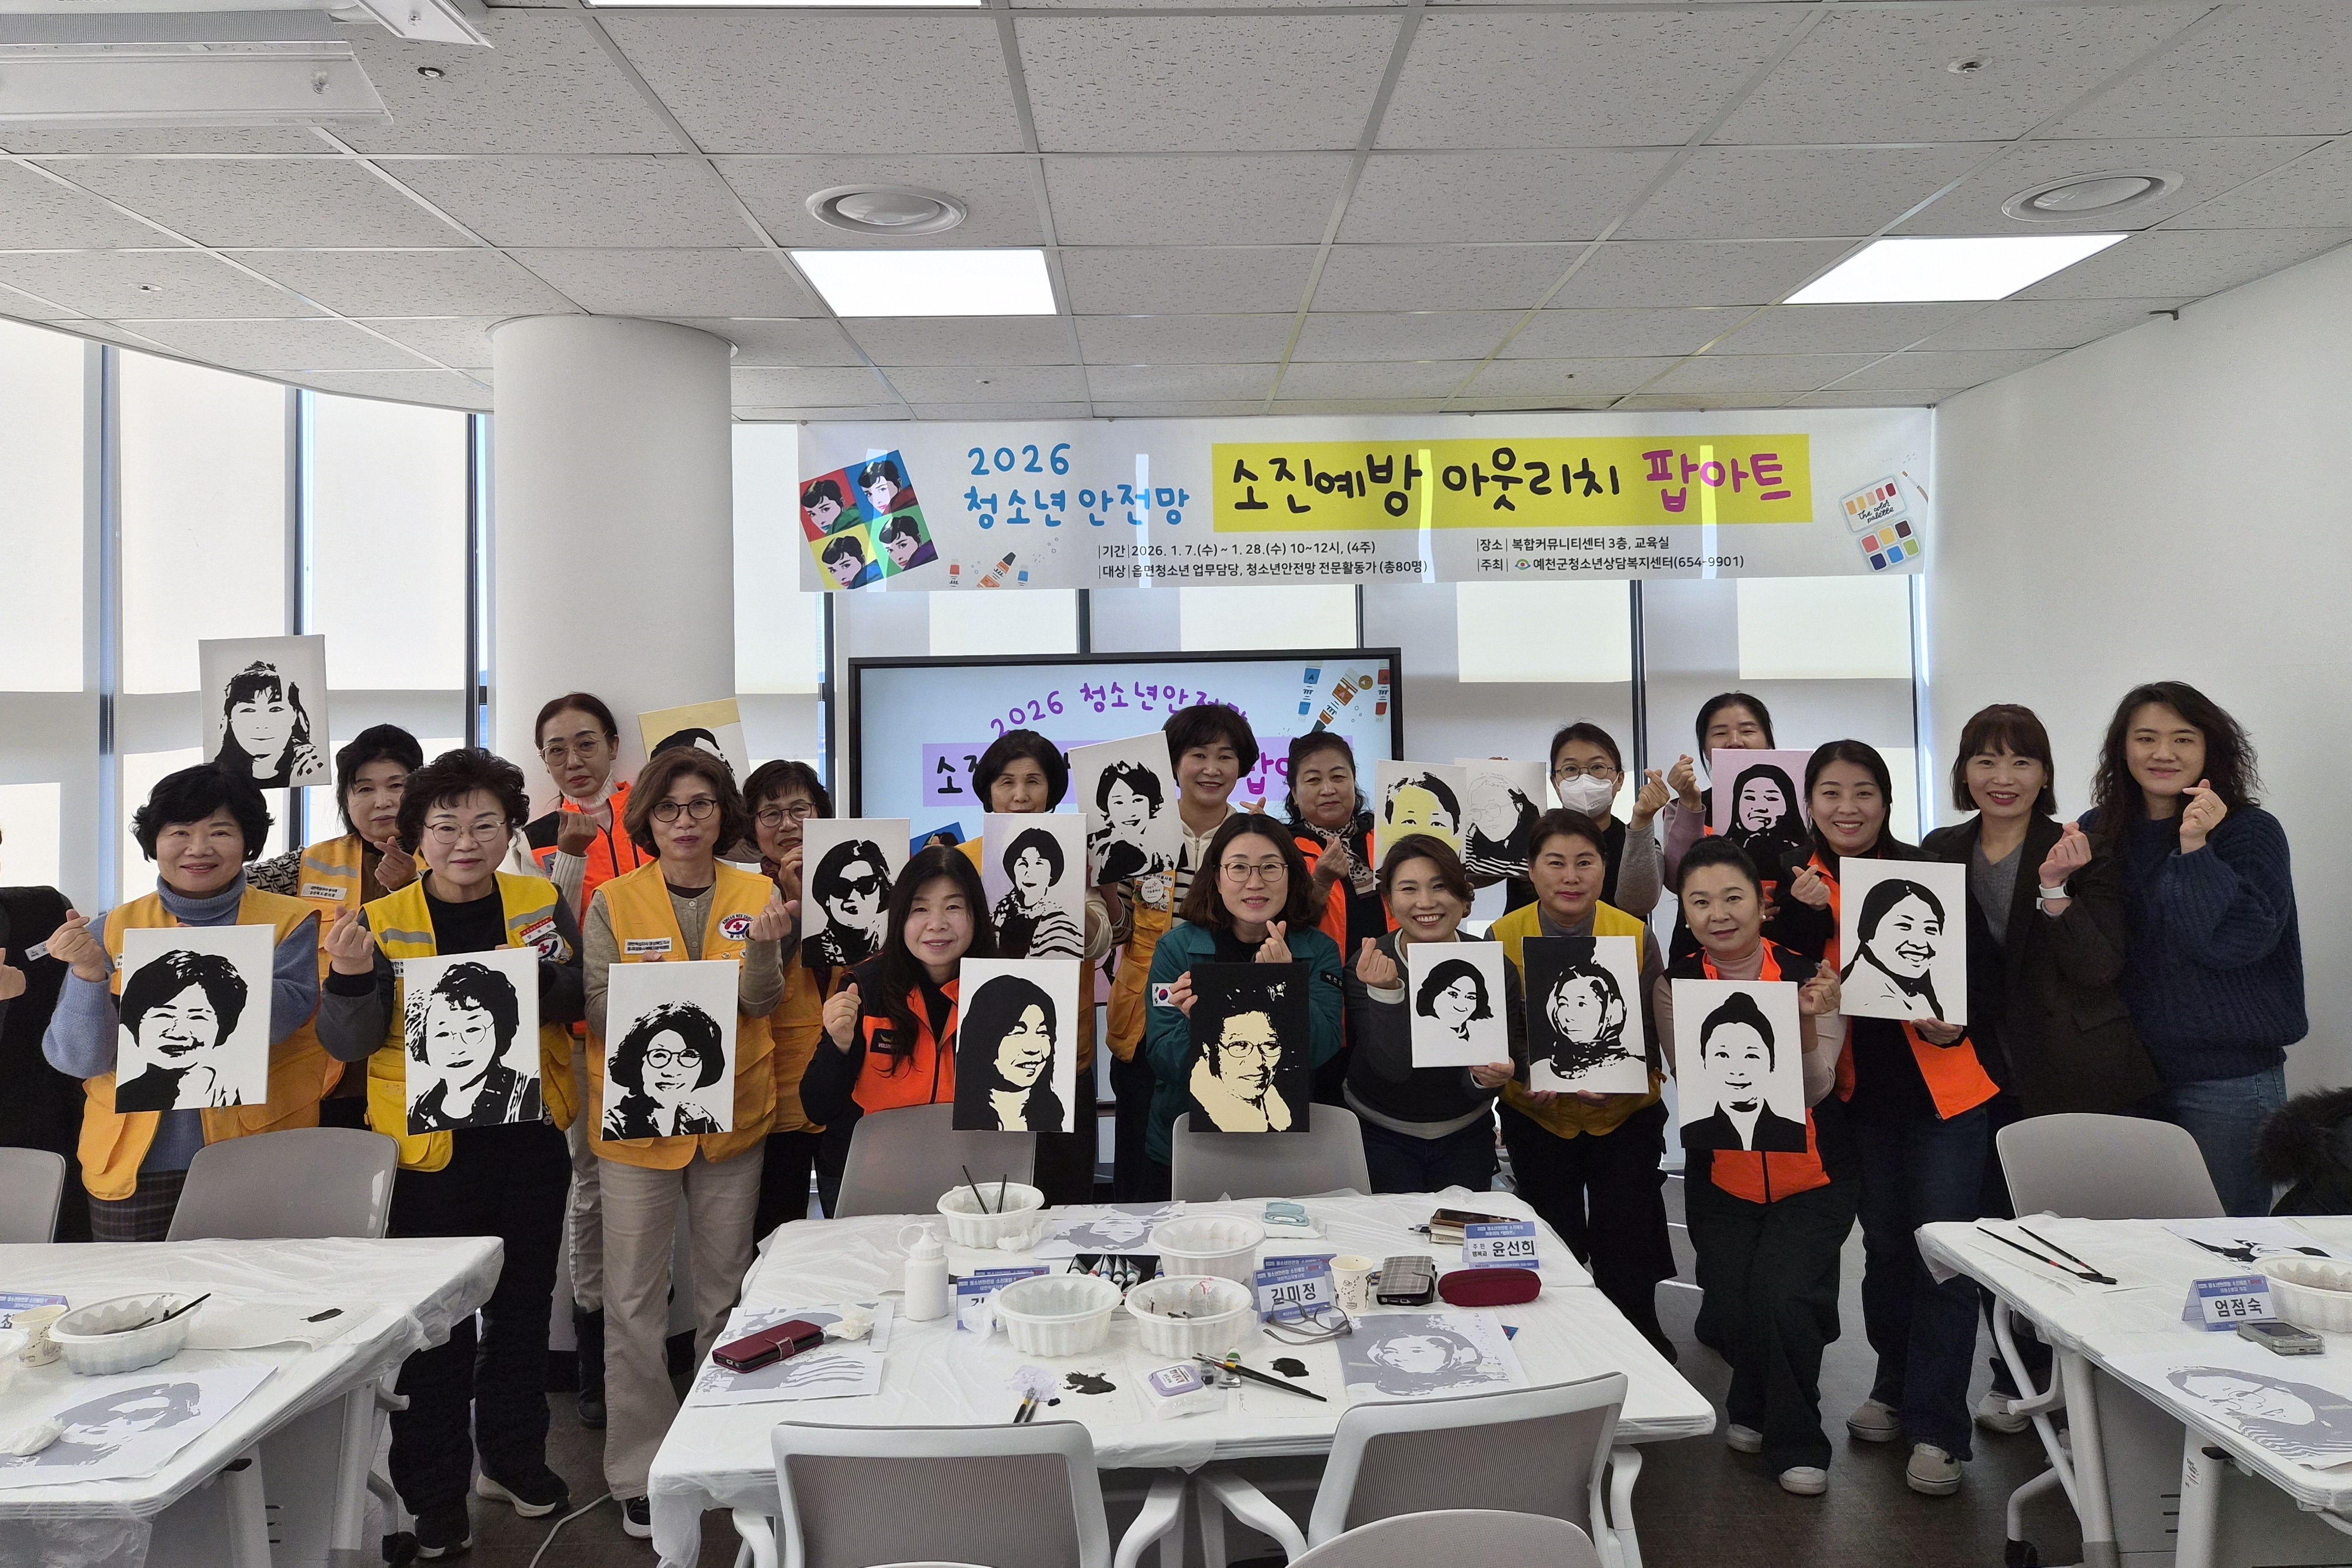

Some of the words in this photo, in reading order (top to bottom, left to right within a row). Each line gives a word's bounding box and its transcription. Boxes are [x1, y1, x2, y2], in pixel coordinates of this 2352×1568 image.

[967, 443, 1071, 476] 2026
[1234, 454, 1422, 517] 소진예방
[1442, 447, 1620, 511] 아웃리치
[1642, 449, 1791, 513] 팝아트
[1857, 510, 1872, 520] The
[1874, 500, 1890, 511] color
[1867, 507, 1894, 524] palette
[1131, 545, 1167, 556] 2026.
[1290, 541, 1344, 554] 10~12시,
[1347, 541, 1375, 554] (4주)
[1512, 537, 1605, 551] 복합커뮤니티센터
[1608, 537, 1631, 550] 3층,
[1634, 536, 1669, 550] 교육실
[1131, 564, 1189, 577] 읍면청소년
[1193, 563, 1243, 577] 업무담당,
[1246, 561, 1316, 576] 청소년안전망
[1319, 561, 1377, 574] 전문활동가
[1379, 560, 1427, 574] (총80명)
[990, 690, 1063, 739] 2026
[1492, 1240, 1535, 1257] 윤선희
[1271, 1282, 1317, 1305] 김미정
[2214, 1298, 2263, 1318] 엄점숙
